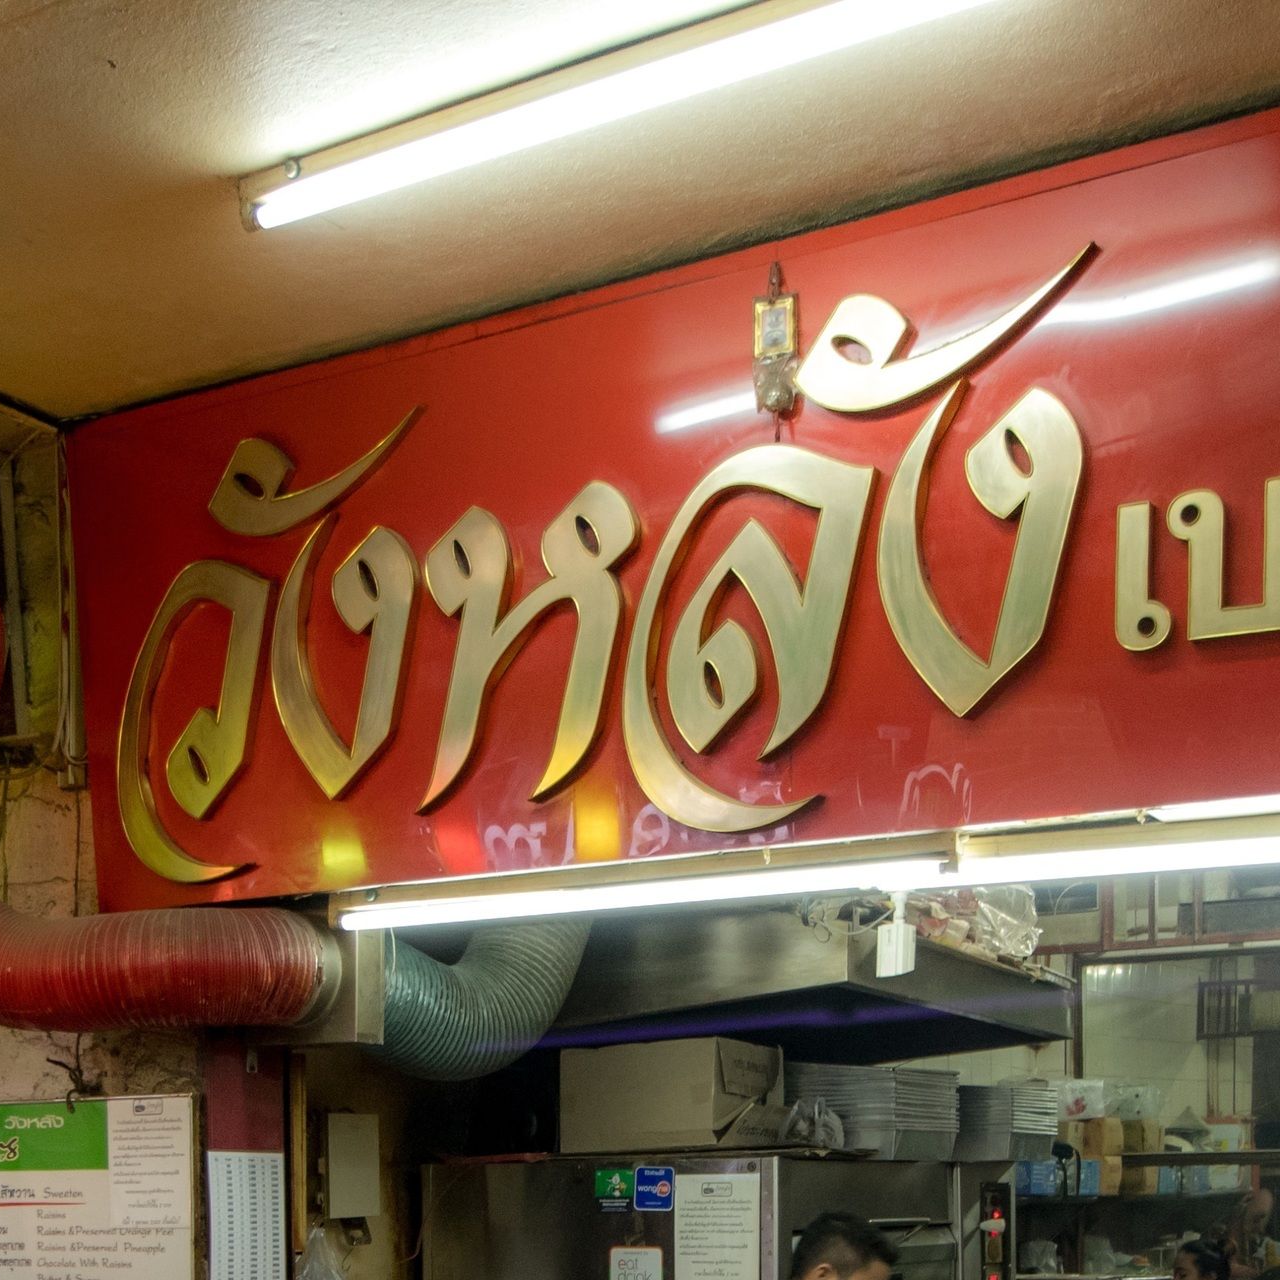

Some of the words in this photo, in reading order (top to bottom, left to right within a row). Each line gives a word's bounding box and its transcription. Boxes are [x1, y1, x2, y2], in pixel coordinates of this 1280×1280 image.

[118, 242, 1102, 885] วังหลัง
[4, 1115, 64, 1130] วังหลัง
[618, 1258, 638, 1271] eat
